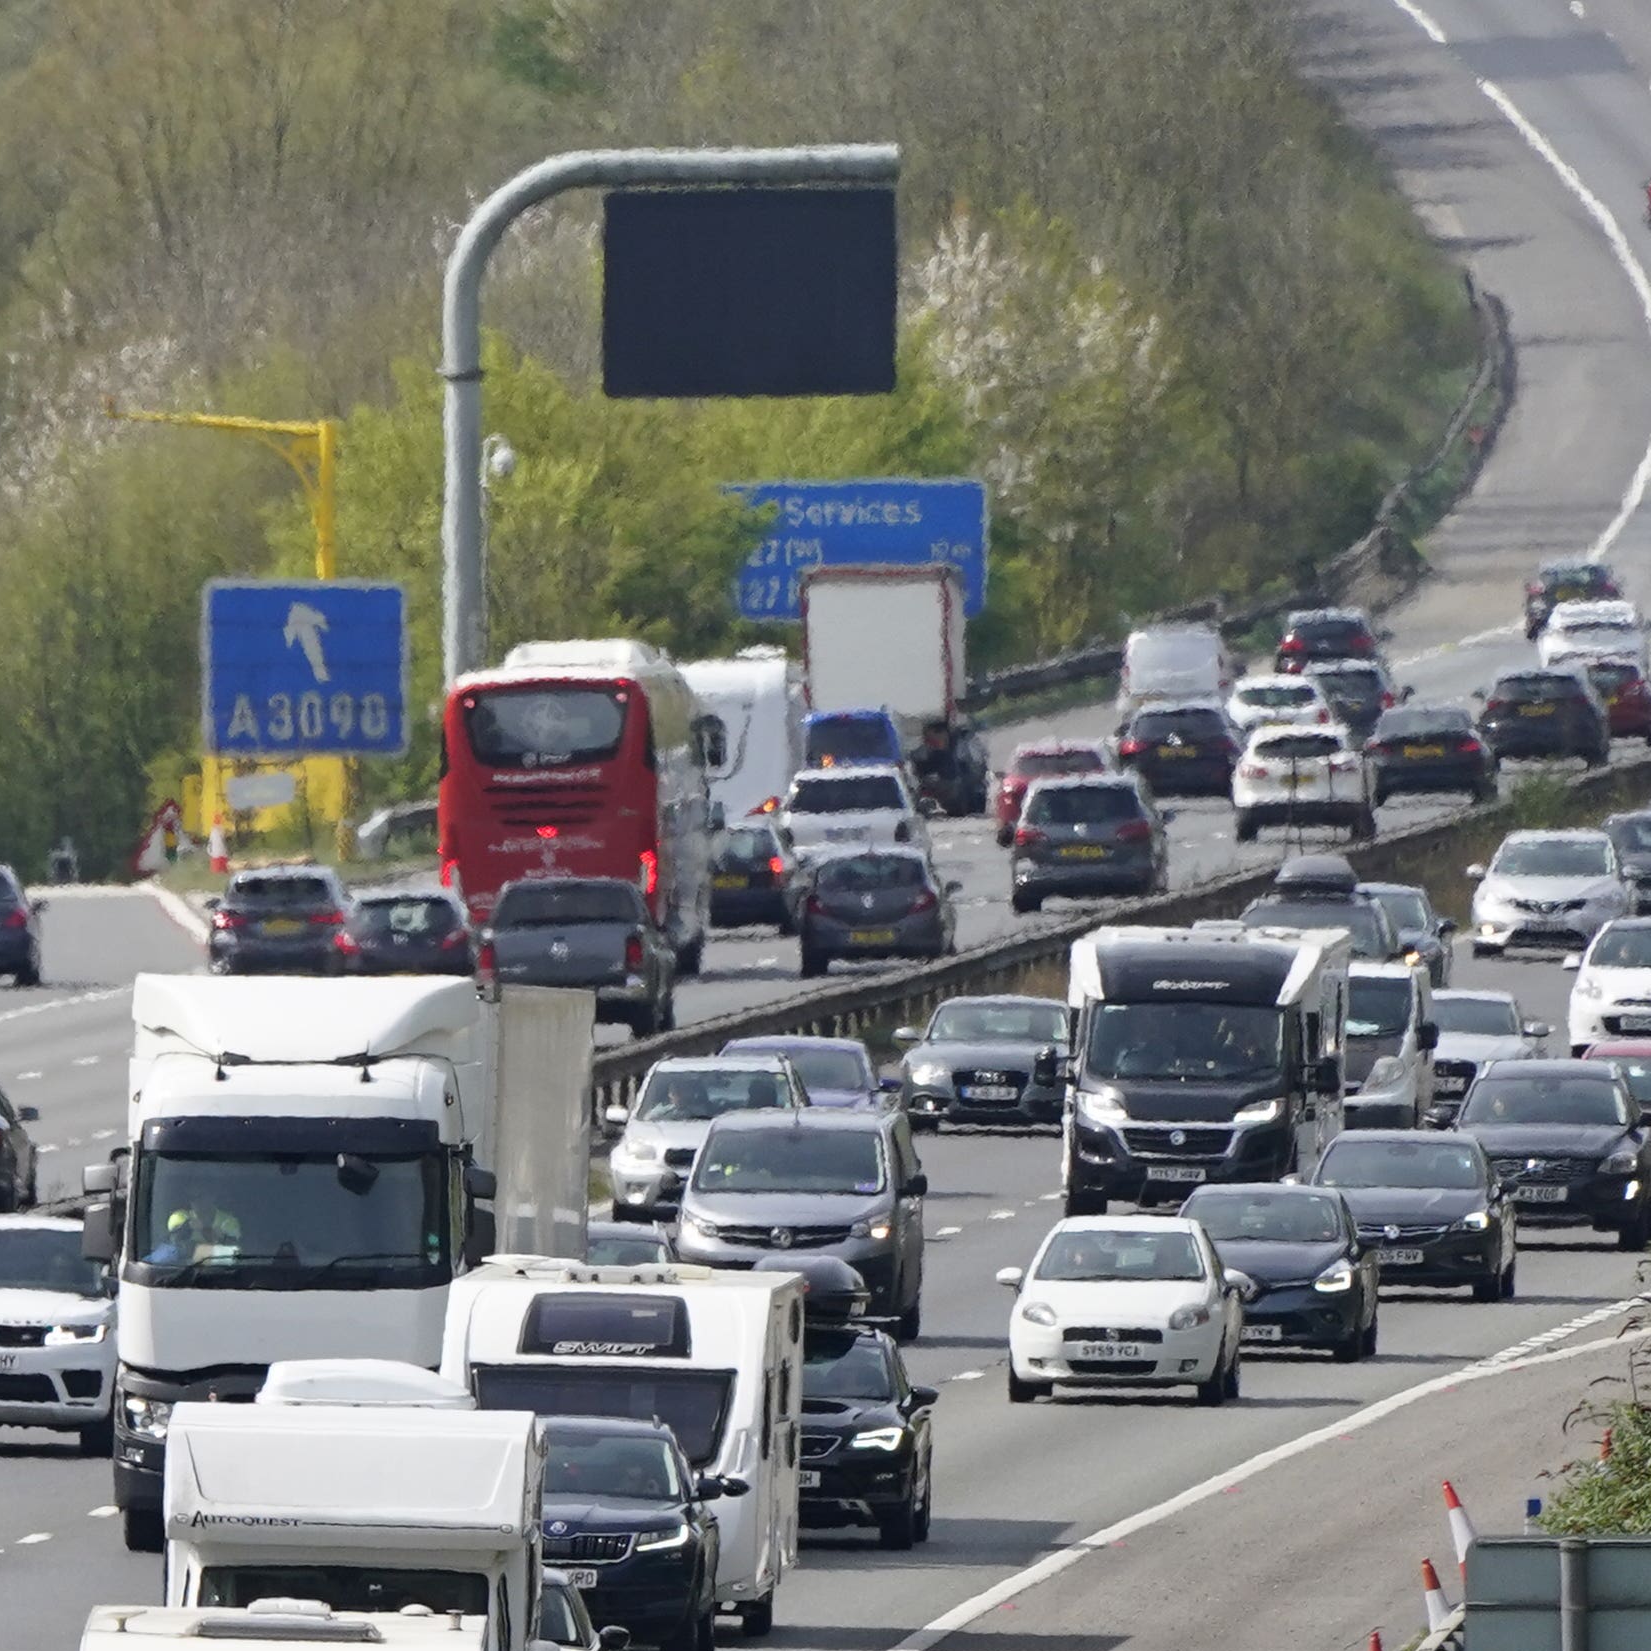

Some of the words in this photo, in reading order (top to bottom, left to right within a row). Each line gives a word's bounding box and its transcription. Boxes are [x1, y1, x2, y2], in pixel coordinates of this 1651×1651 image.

[785, 498, 922, 527] Services
[227, 690, 389, 741] A3090
[553, 1340, 655, 1355] SWIFT
